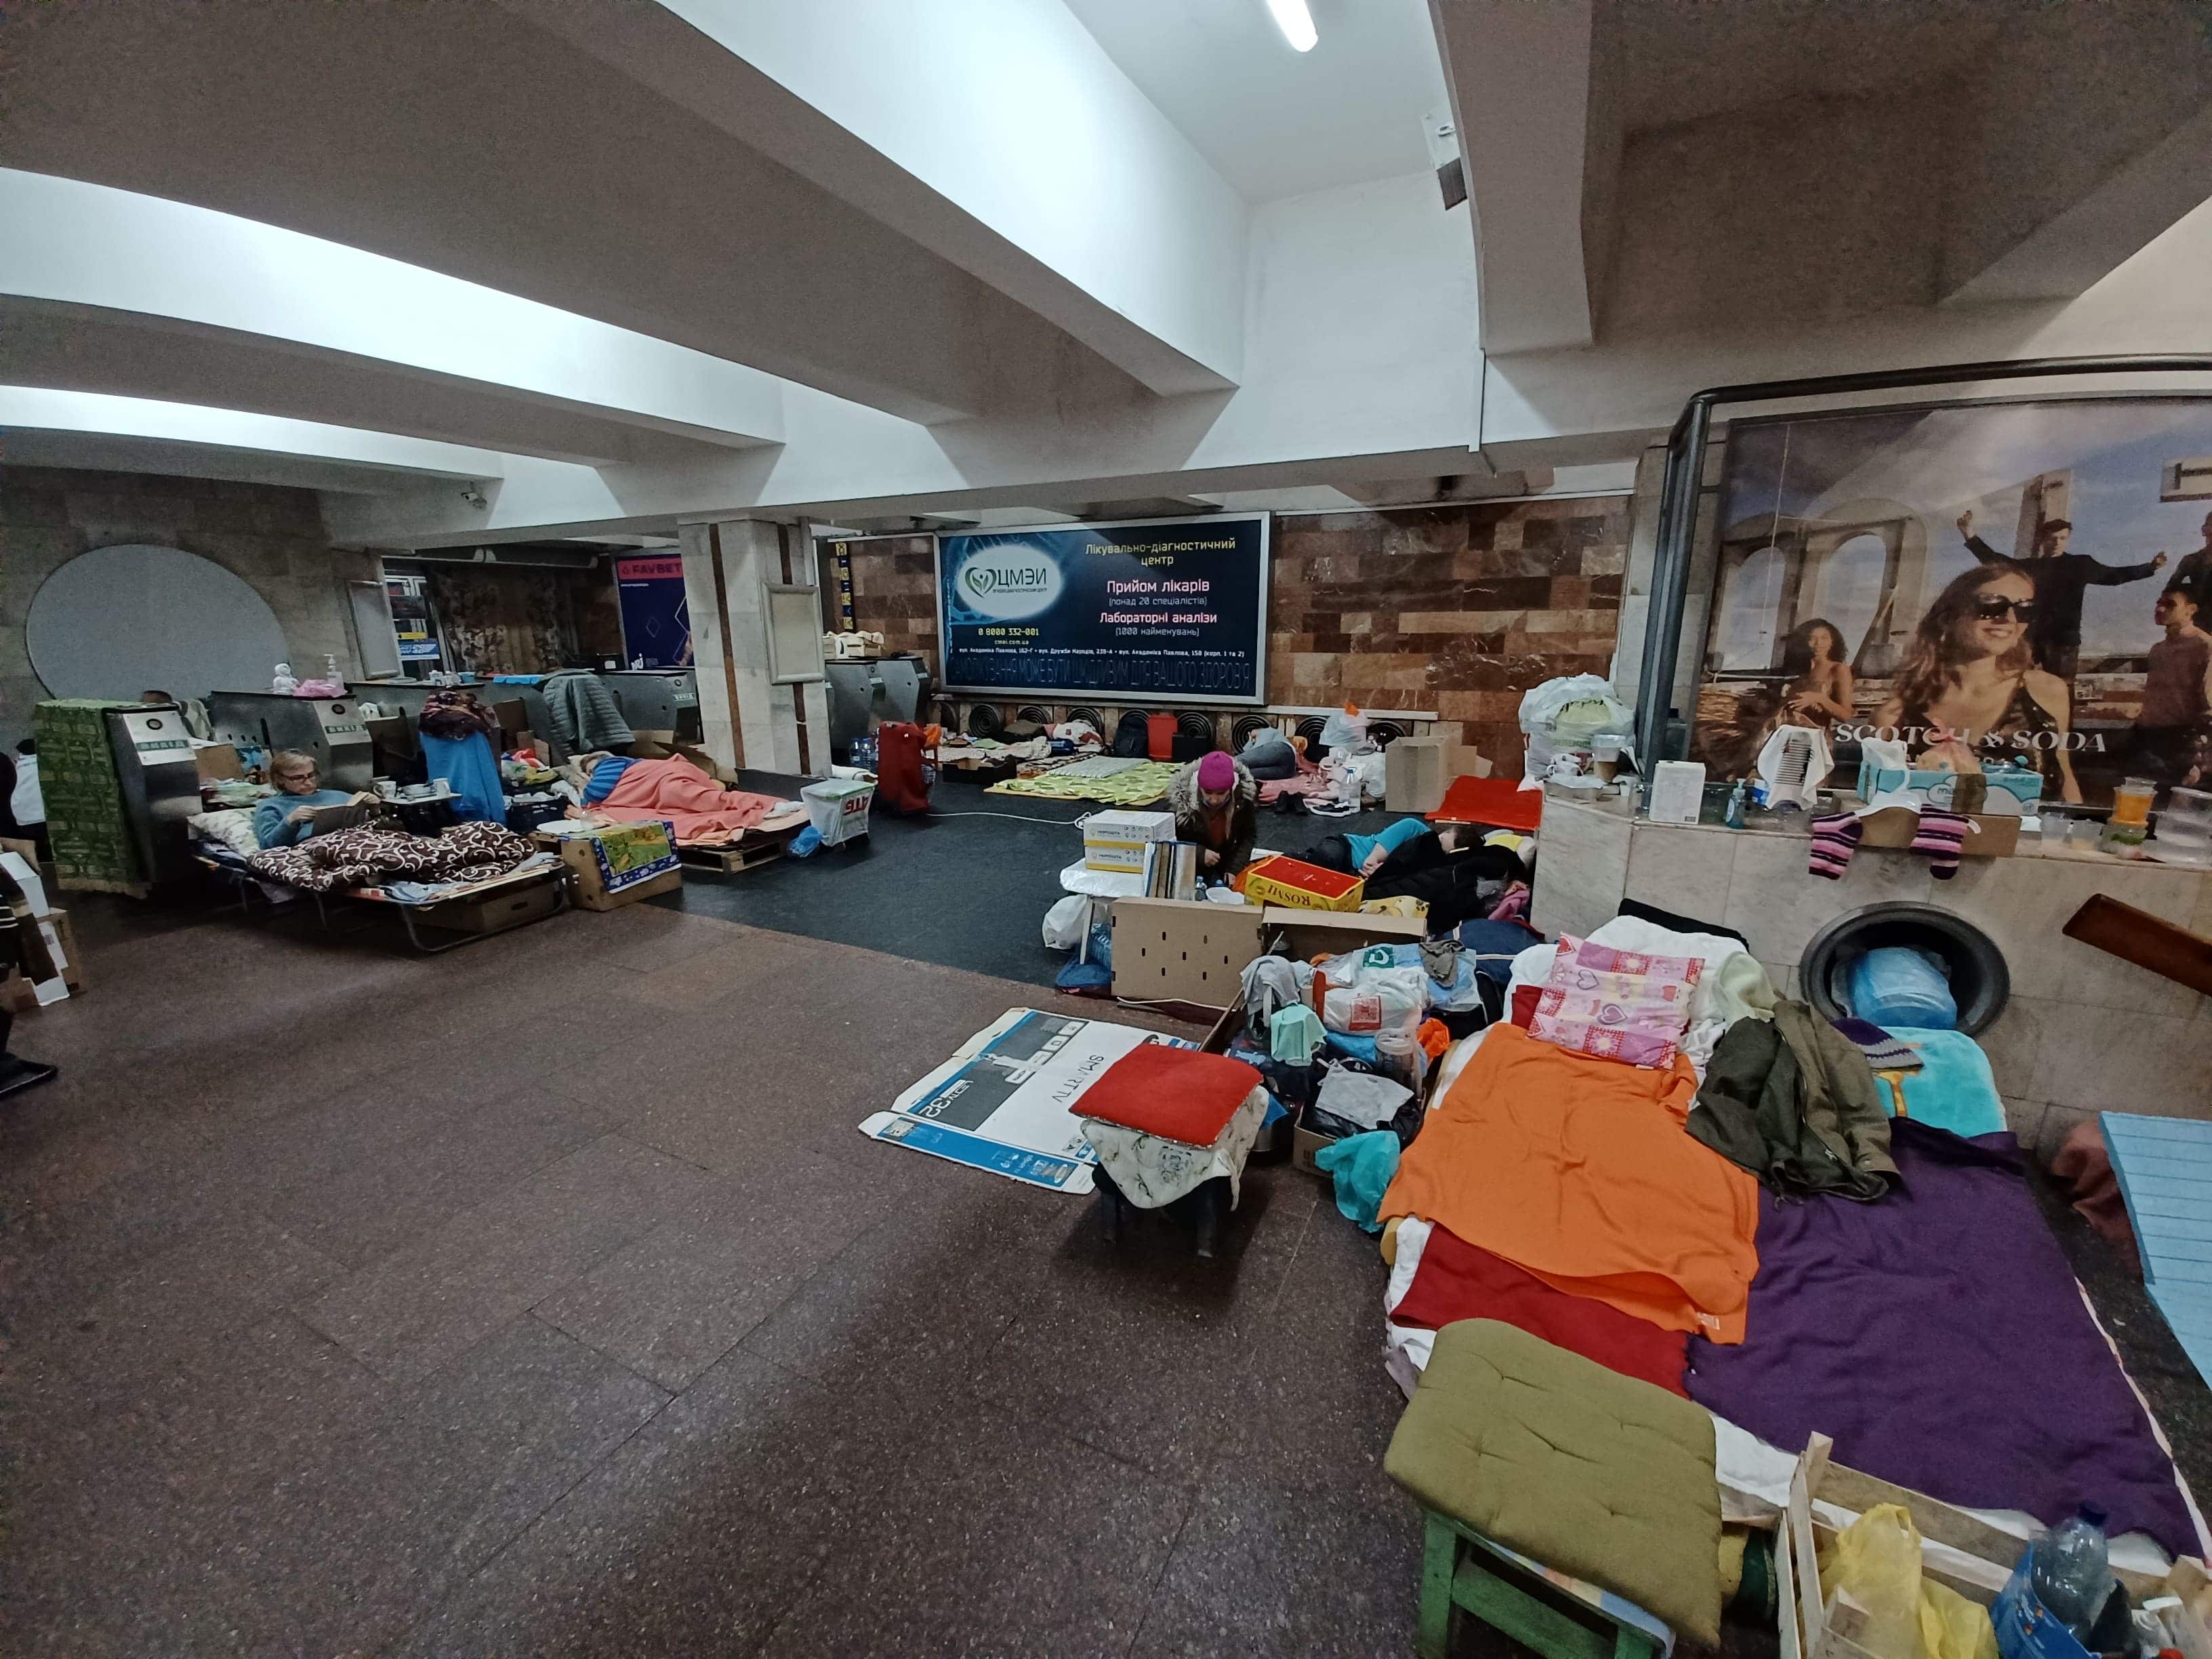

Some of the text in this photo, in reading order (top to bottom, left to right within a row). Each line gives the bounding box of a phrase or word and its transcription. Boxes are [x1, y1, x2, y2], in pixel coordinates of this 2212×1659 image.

[1086, 537, 1235, 556] Лікувально-діагностичний
[632, 563, 680, 573] FAVBET
[1141, 556, 1174, 567] центр
[998, 568, 1046, 588] ЦМЭИ
[1107, 579, 1210, 595] Прийом лікарів
[1109, 597, 1207, 607] (понад 20 спеціалістів)
[1100, 611, 1217, 625] Лабораторні аналізи
[978, 628, 1040, 636] 0 8000 332-001
[1115, 628, 1200, 637] (1000 найменувань)
[1980, 731, 2005, 748] &
[2011, 729, 2107, 752] SODA
[918, 1099, 951, 1118] 32
